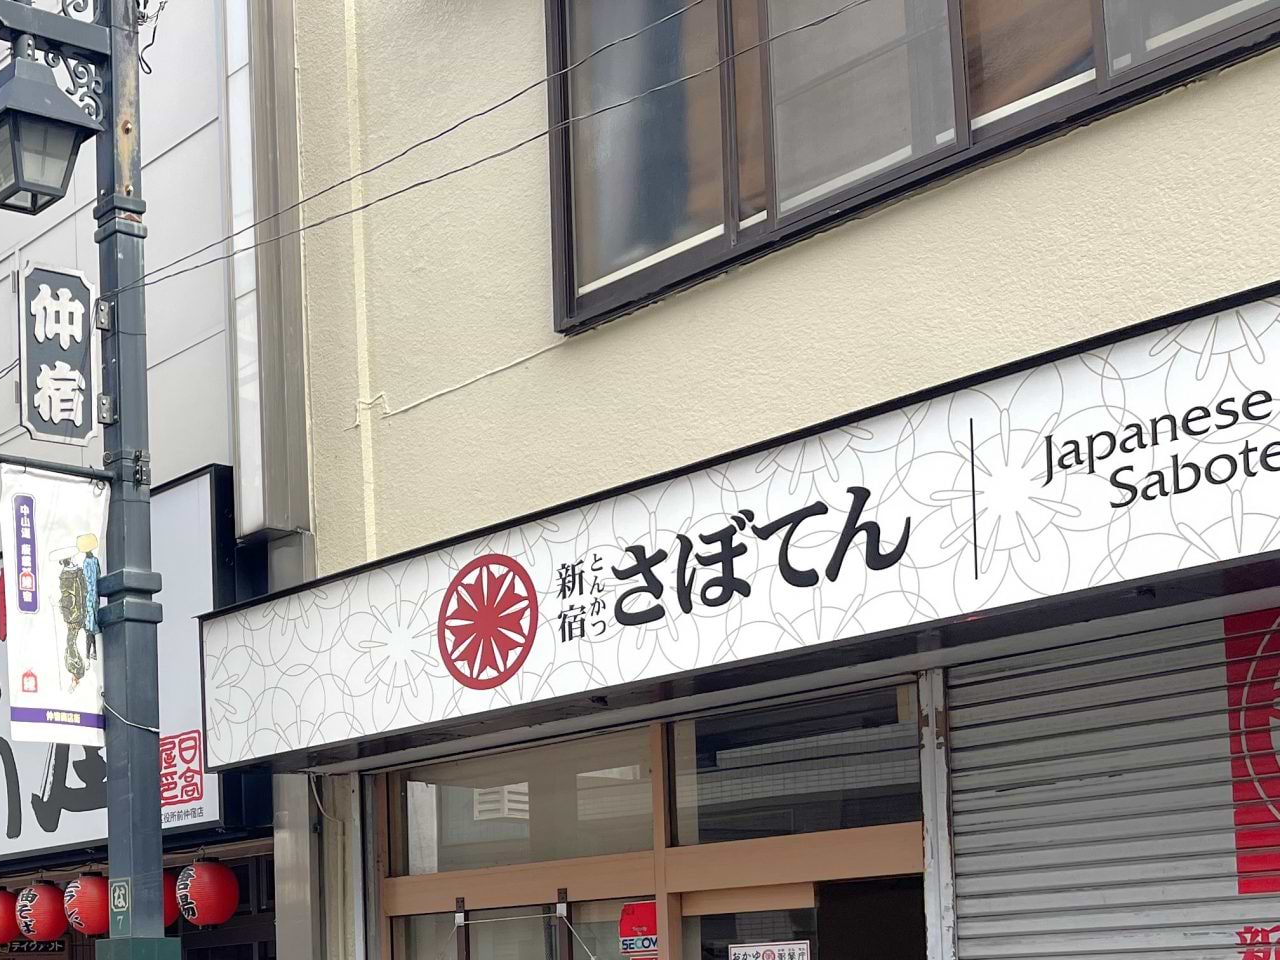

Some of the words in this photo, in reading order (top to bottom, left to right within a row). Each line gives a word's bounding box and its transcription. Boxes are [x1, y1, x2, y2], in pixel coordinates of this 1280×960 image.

[29, 282, 88, 430] 仲宿
[1041, 389, 1273, 488] Japanese
[556, 558, 587, 643] 新宿
[588, 553, 607, 638] とんかつ
[611, 486, 912, 627] さぼてん
[732, 950, 761, 960] おかゆ
